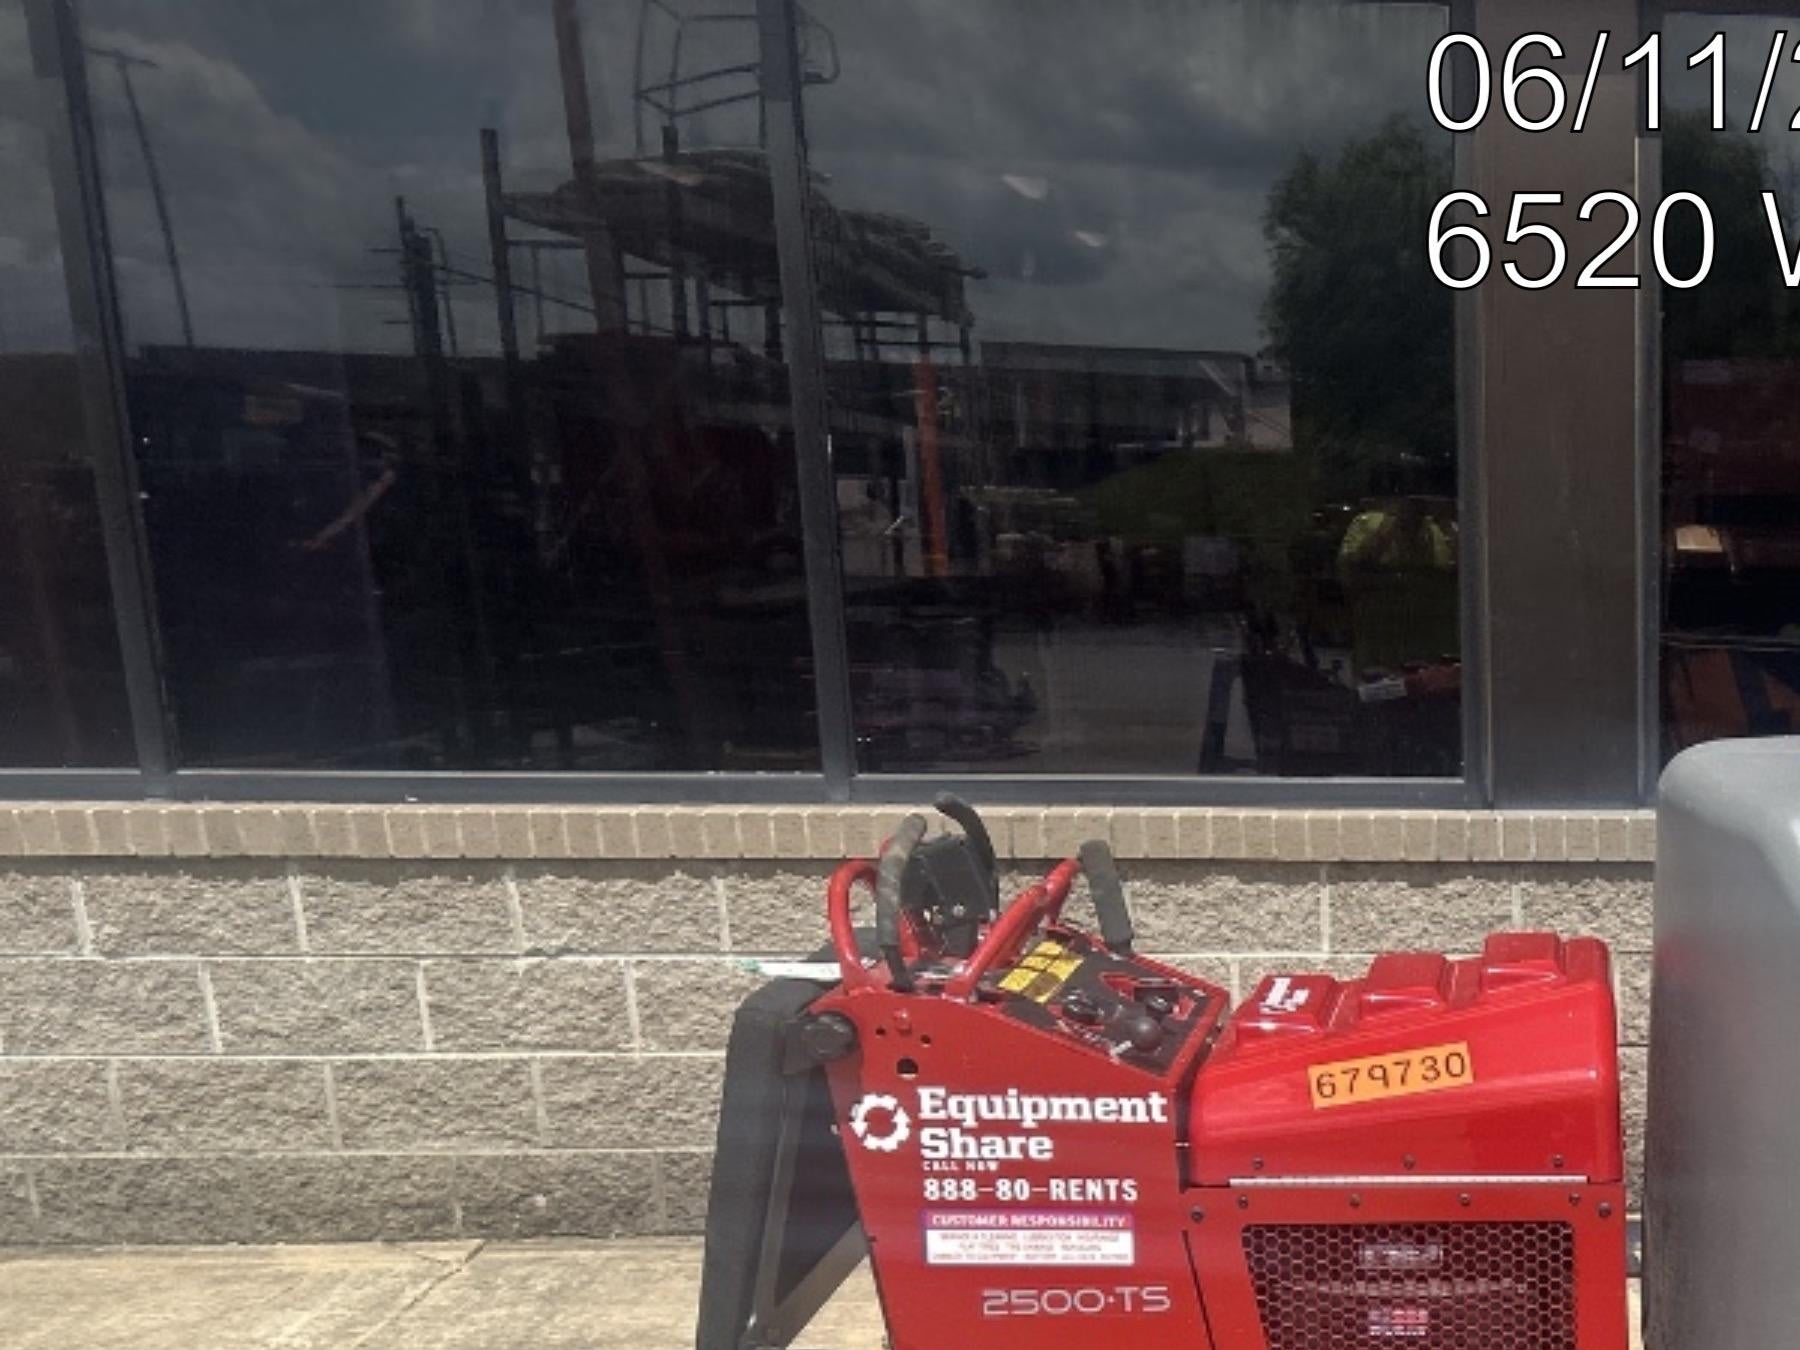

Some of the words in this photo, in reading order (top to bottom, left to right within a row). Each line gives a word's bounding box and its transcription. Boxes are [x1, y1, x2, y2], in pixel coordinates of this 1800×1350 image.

[1315, 1051, 1466, 1098] 679730
[917, 1086, 1168, 1128] Equipment
[919, 1126, 1054, 1161] Share
[923, 1160, 959, 1171] CALL
[923, 1177, 1139, 1202] 888-80-RENTS
[932, 1213, 1009, 1228] CUSTOMER
[1011, 1214, 1127, 1229] RESPONSIBILITY
